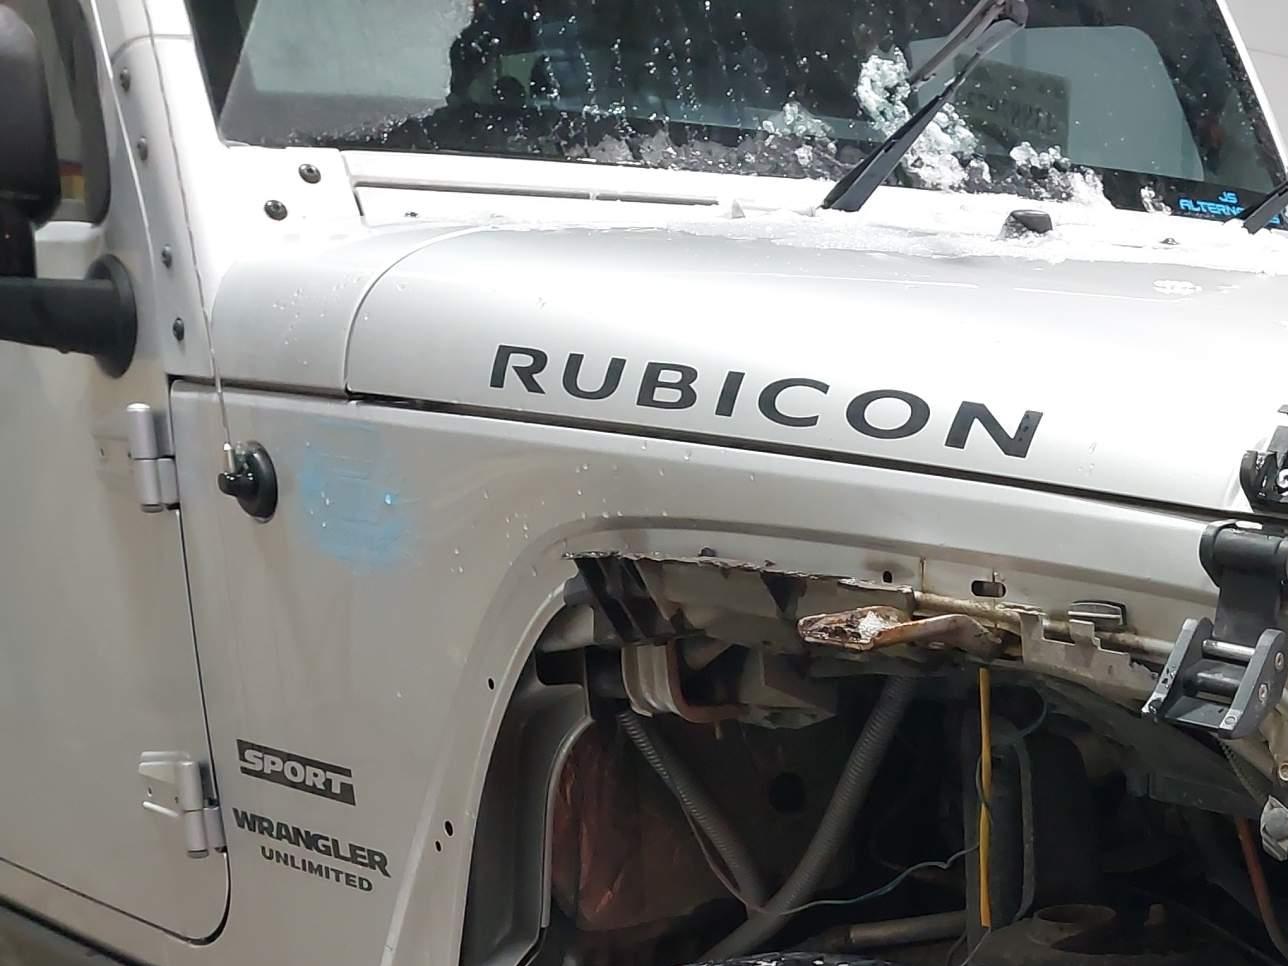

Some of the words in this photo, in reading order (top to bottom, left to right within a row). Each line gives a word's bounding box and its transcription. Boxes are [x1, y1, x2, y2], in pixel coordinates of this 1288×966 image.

[490, 344, 1044, 459] RUBICON
[240, 747, 354, 796] SPORT
[232, 807, 392, 879] WRANGLER
[260, 845, 374, 893] UNLIMITED
